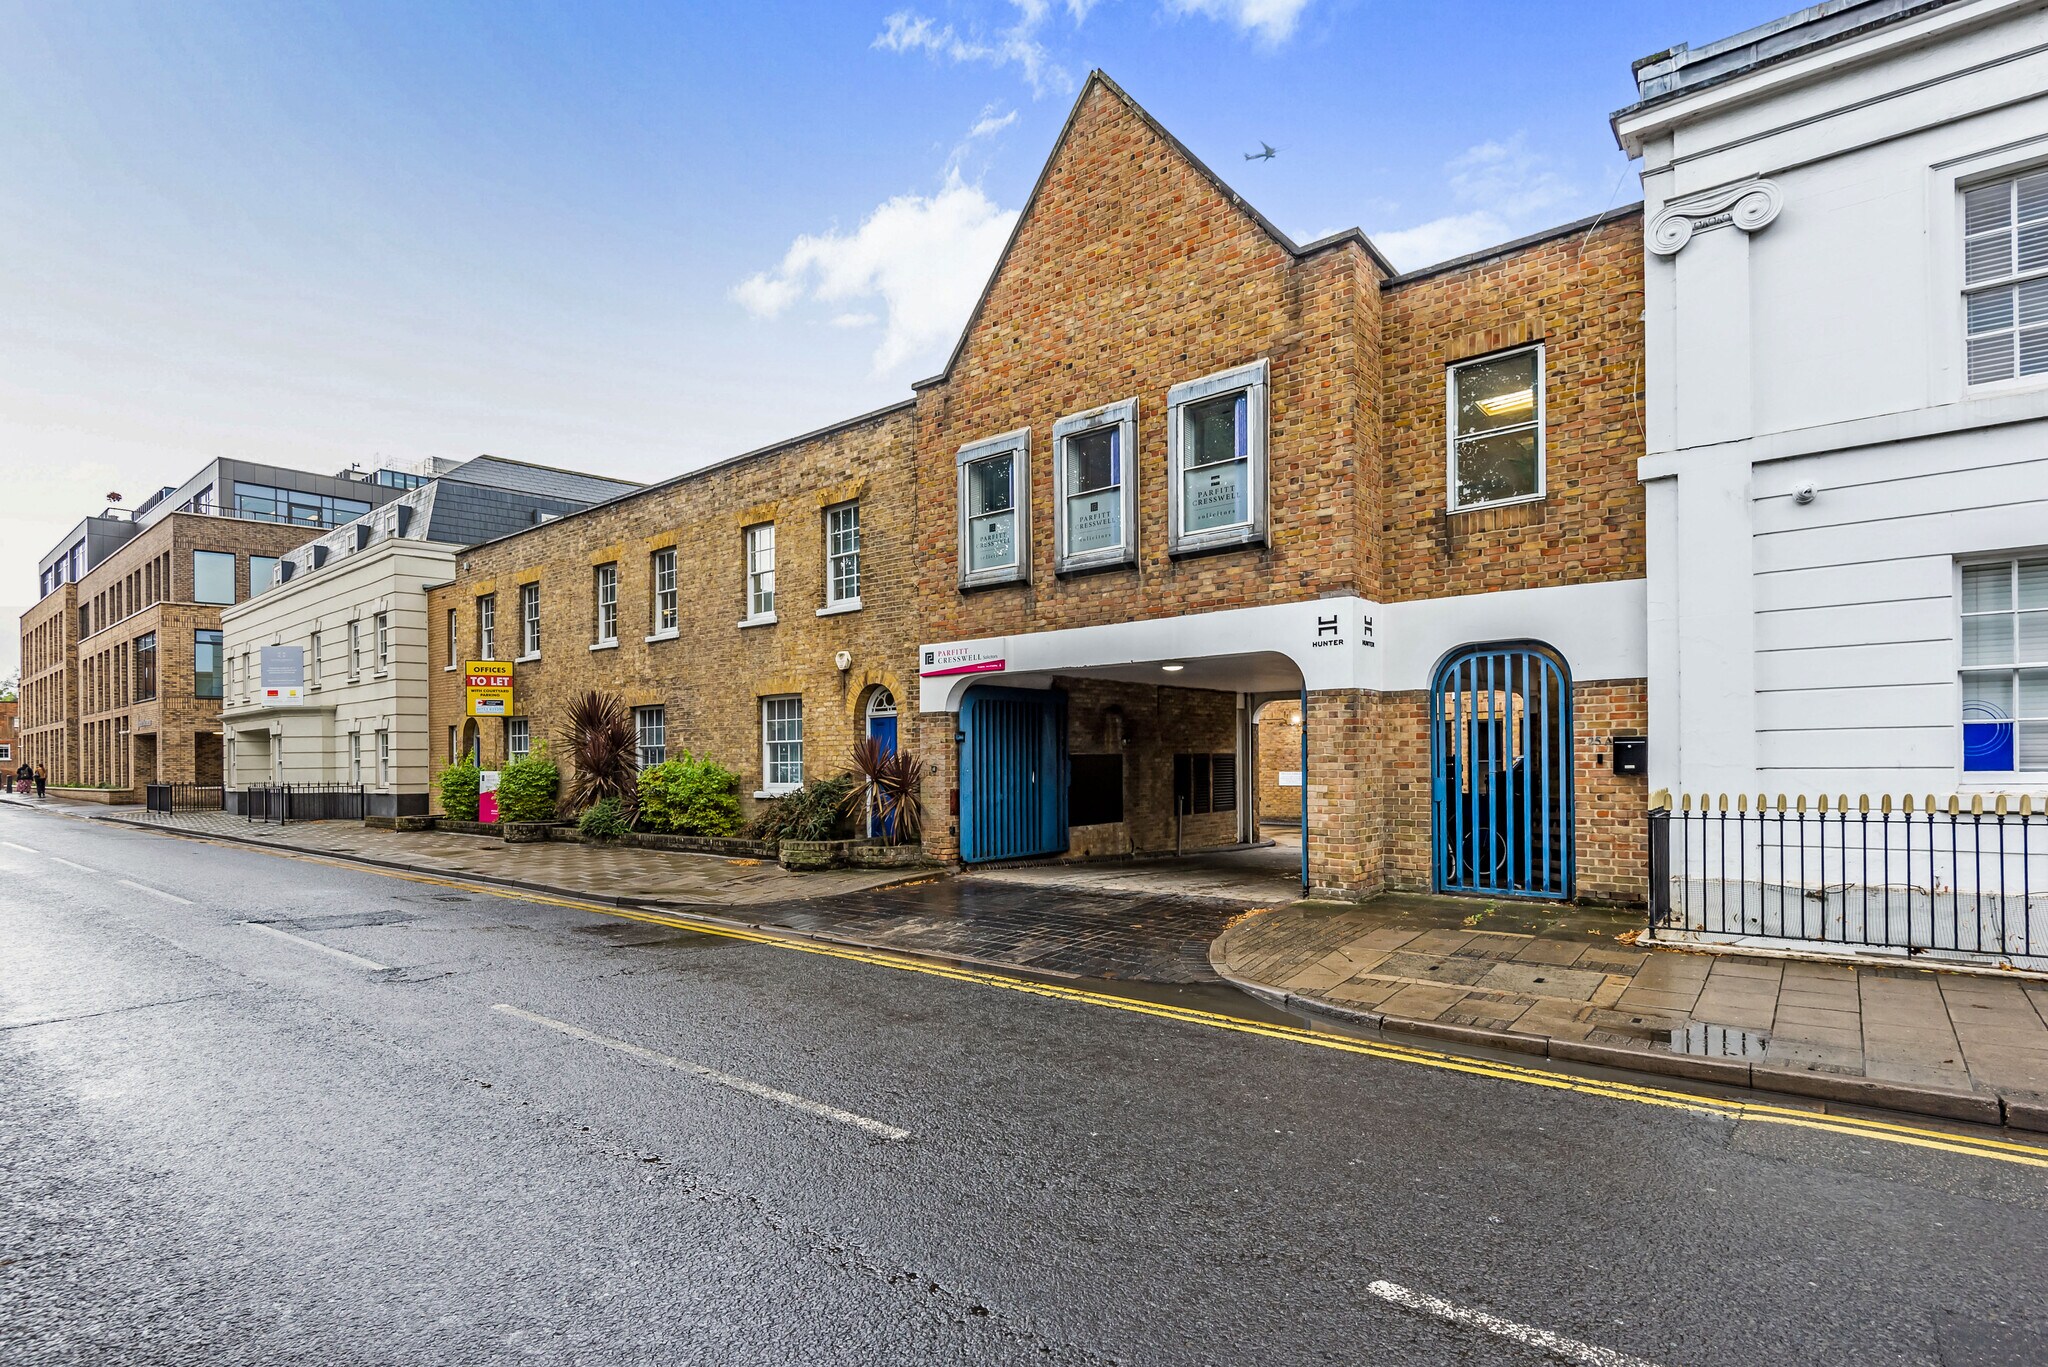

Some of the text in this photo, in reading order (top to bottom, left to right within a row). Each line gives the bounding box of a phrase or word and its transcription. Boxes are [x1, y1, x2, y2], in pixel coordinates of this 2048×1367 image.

[1198, 485, 1235, 498] PARFITT
[1192, 492, 1240, 506] CRESSWELL
[1079, 511, 1111, 522] PARFITT
[1312, 639, 1344, 648] HUNTER
[937, 647, 969, 657] PARFITT
[937, 654, 982, 664] CRESSWELL
[471, 677, 509, 686] TO LET
